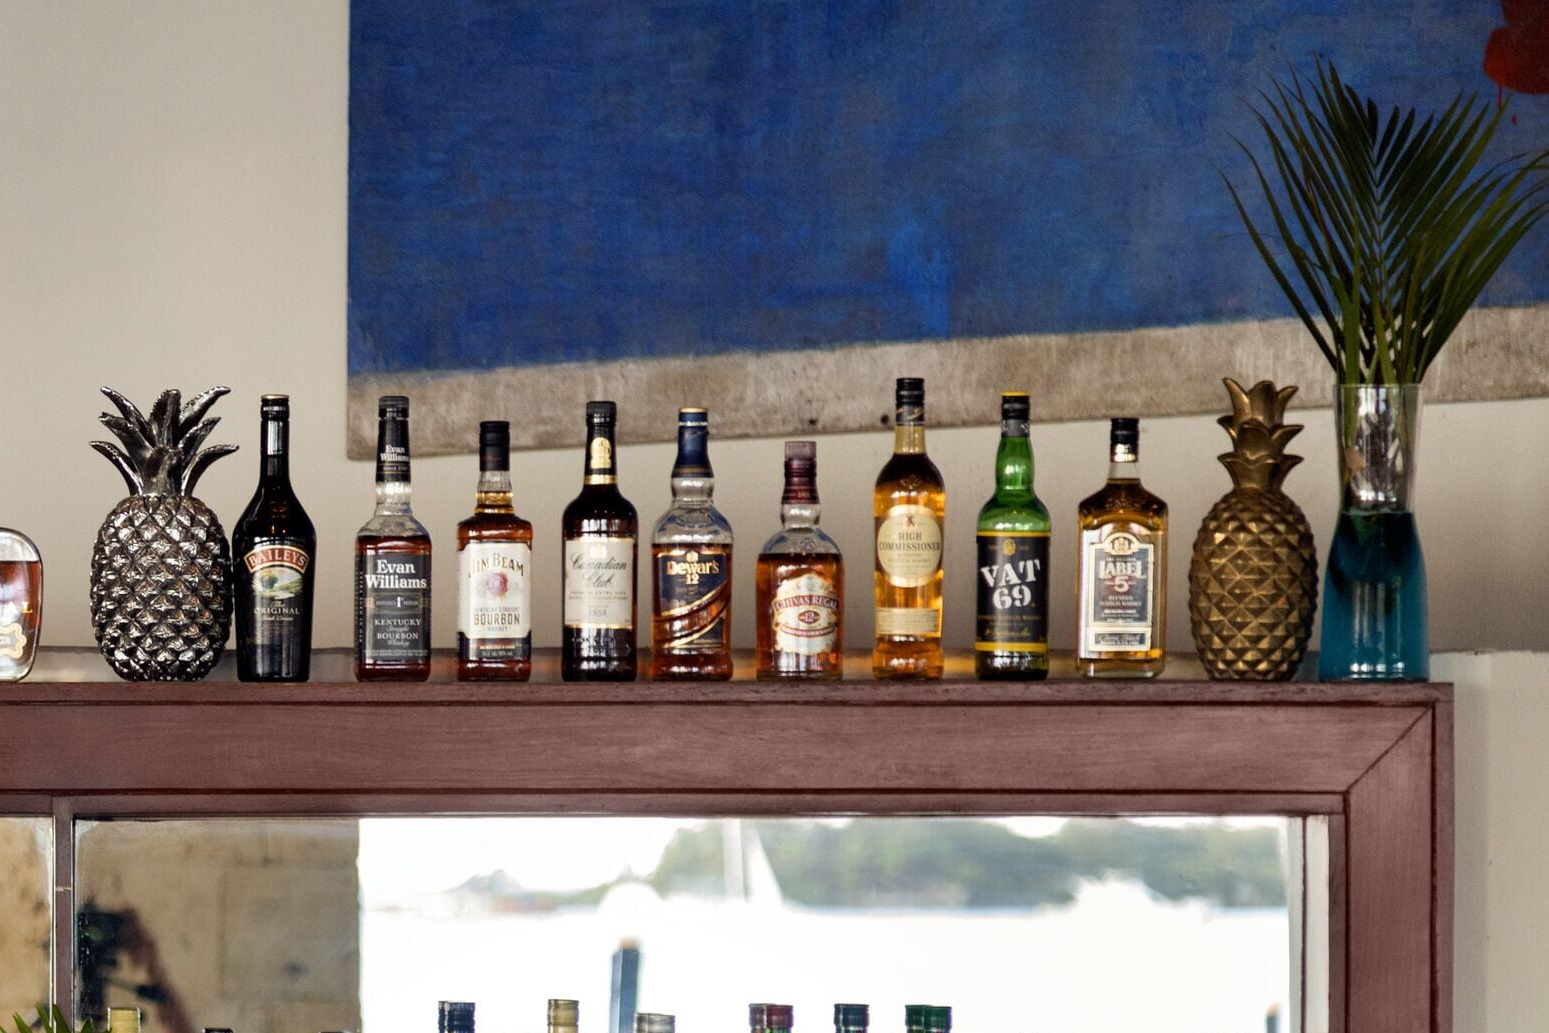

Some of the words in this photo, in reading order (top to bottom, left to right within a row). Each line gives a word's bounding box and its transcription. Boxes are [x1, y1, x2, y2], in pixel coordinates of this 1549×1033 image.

[385, 444, 405, 453] Evan
[898, 532, 922, 541] HIGH
[248, 549, 307, 567] BAILEYS
[493, 552, 524, 577] BEAM
[376, 559, 416, 574] Evan
[666, 559, 720, 575] Dewar's
[980, 558, 1041, 588] VAT
[1099, 560, 1148, 579] LABEL
[365, 574, 427, 589] Williams
[686, 574, 699, 585] 12
[1113, 575, 1129, 593] 5
[776, 595, 810, 609] CHIVAS
[993, 584, 1032, 610] 69
[253, 607, 300, 615] ORIGINAL
[474, 613, 520, 625] BOURBON
